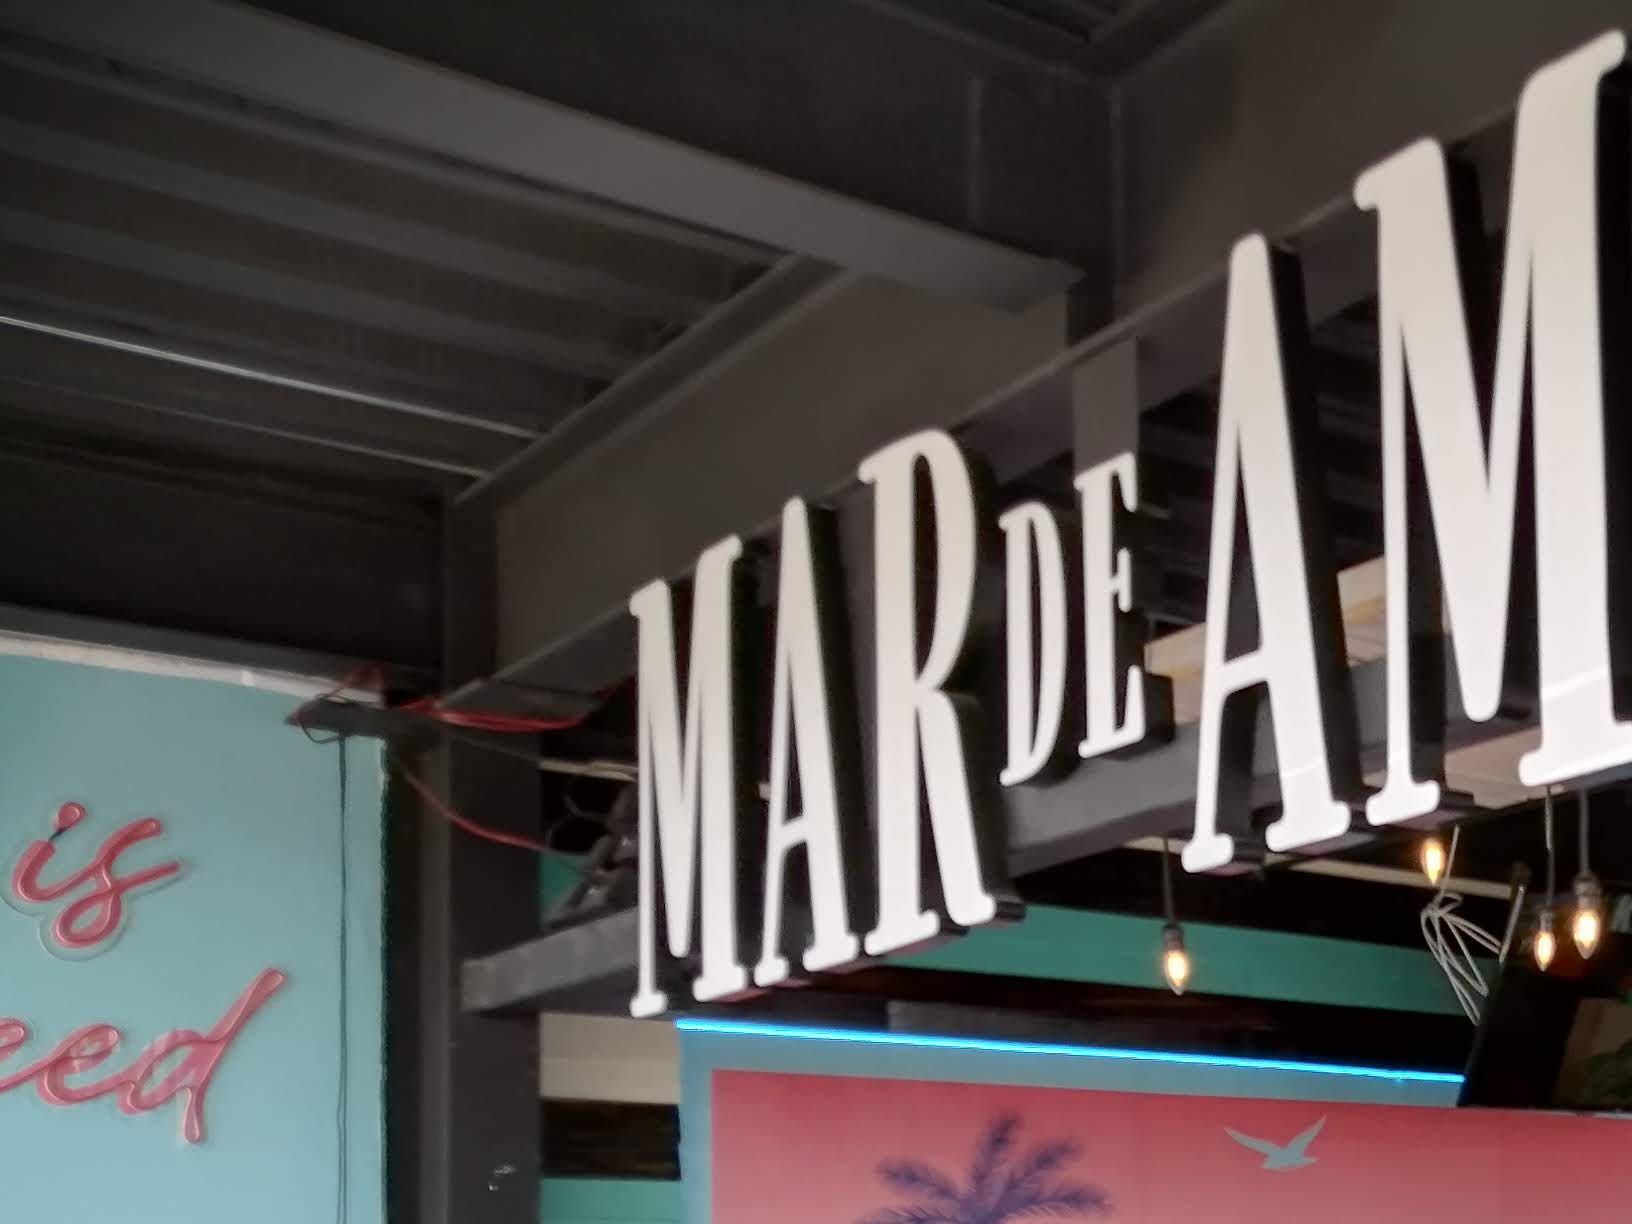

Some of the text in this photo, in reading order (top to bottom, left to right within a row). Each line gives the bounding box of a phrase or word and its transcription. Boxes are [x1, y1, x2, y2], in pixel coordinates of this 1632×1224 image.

[11, 800, 181, 949] is
[630, 428, 997, 1018] MAR
[998, 452, 1145, 786] DE
